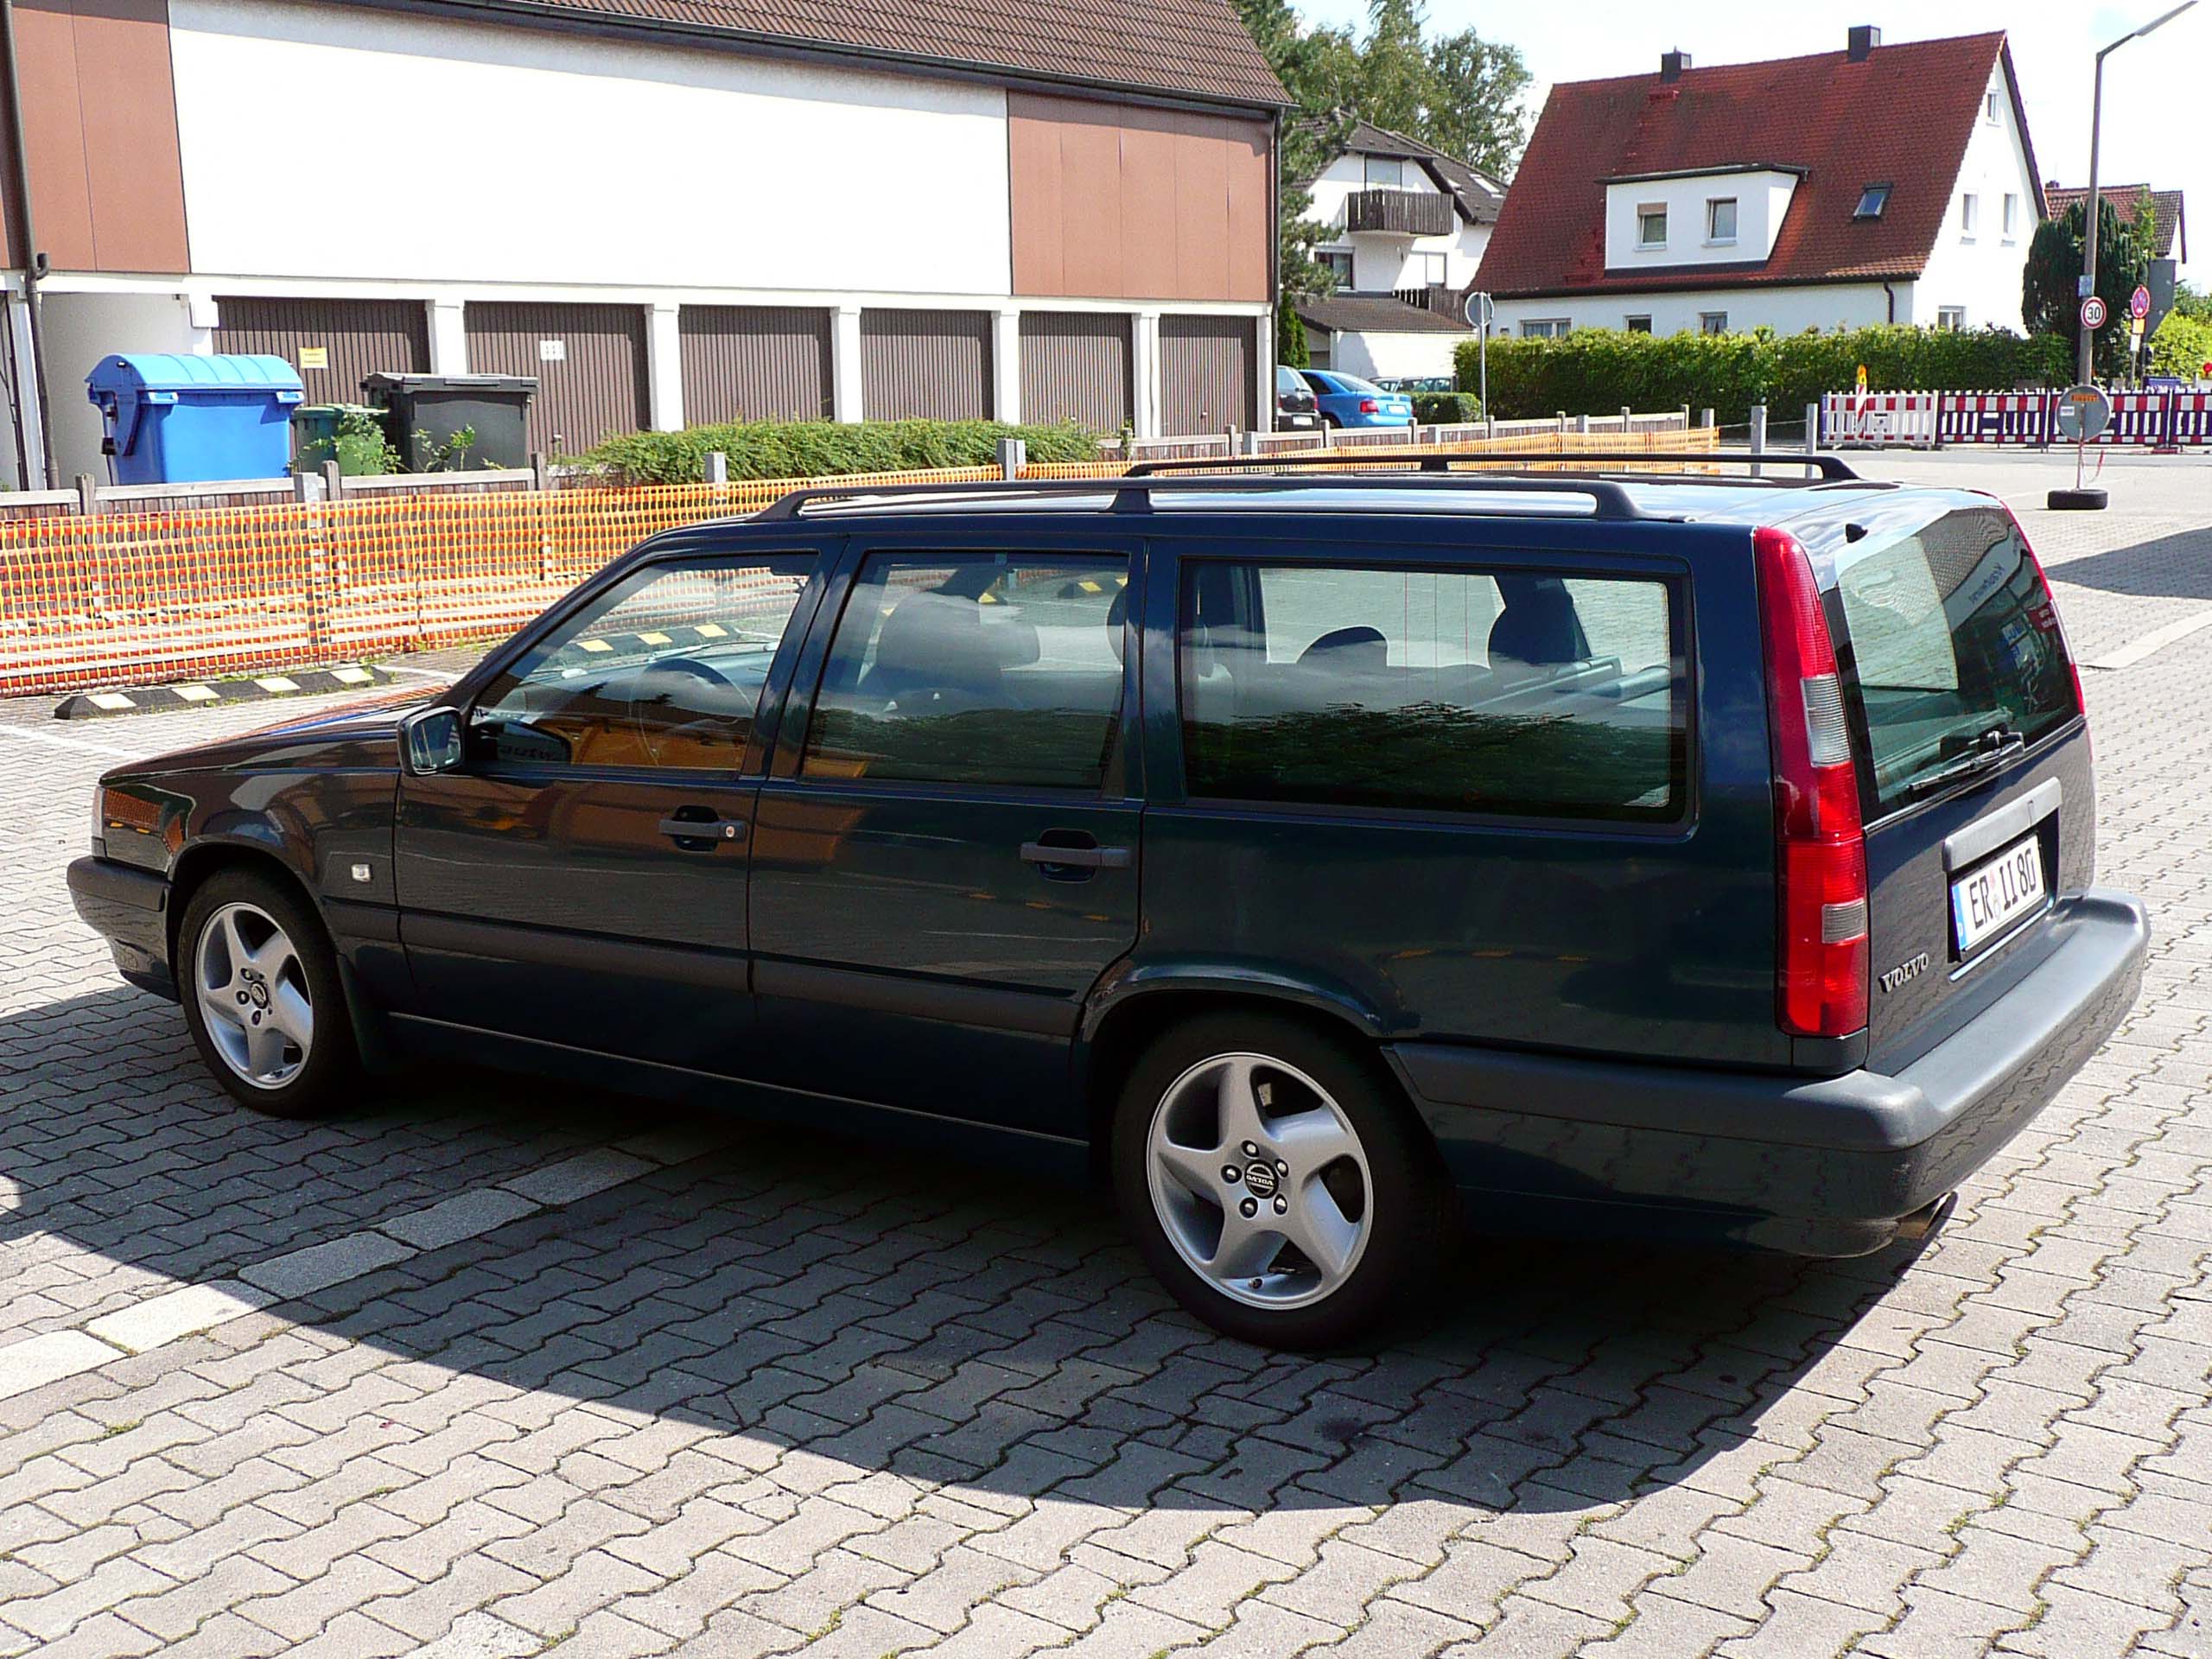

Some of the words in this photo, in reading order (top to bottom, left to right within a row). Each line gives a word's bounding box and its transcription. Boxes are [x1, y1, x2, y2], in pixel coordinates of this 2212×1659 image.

[2088, 306, 2101, 320] 30
[1969, 875, 1993, 930] ER
[1878, 951, 1929, 993] VOLVO
[1246, 1175, 1274, 1185] VOLVO
